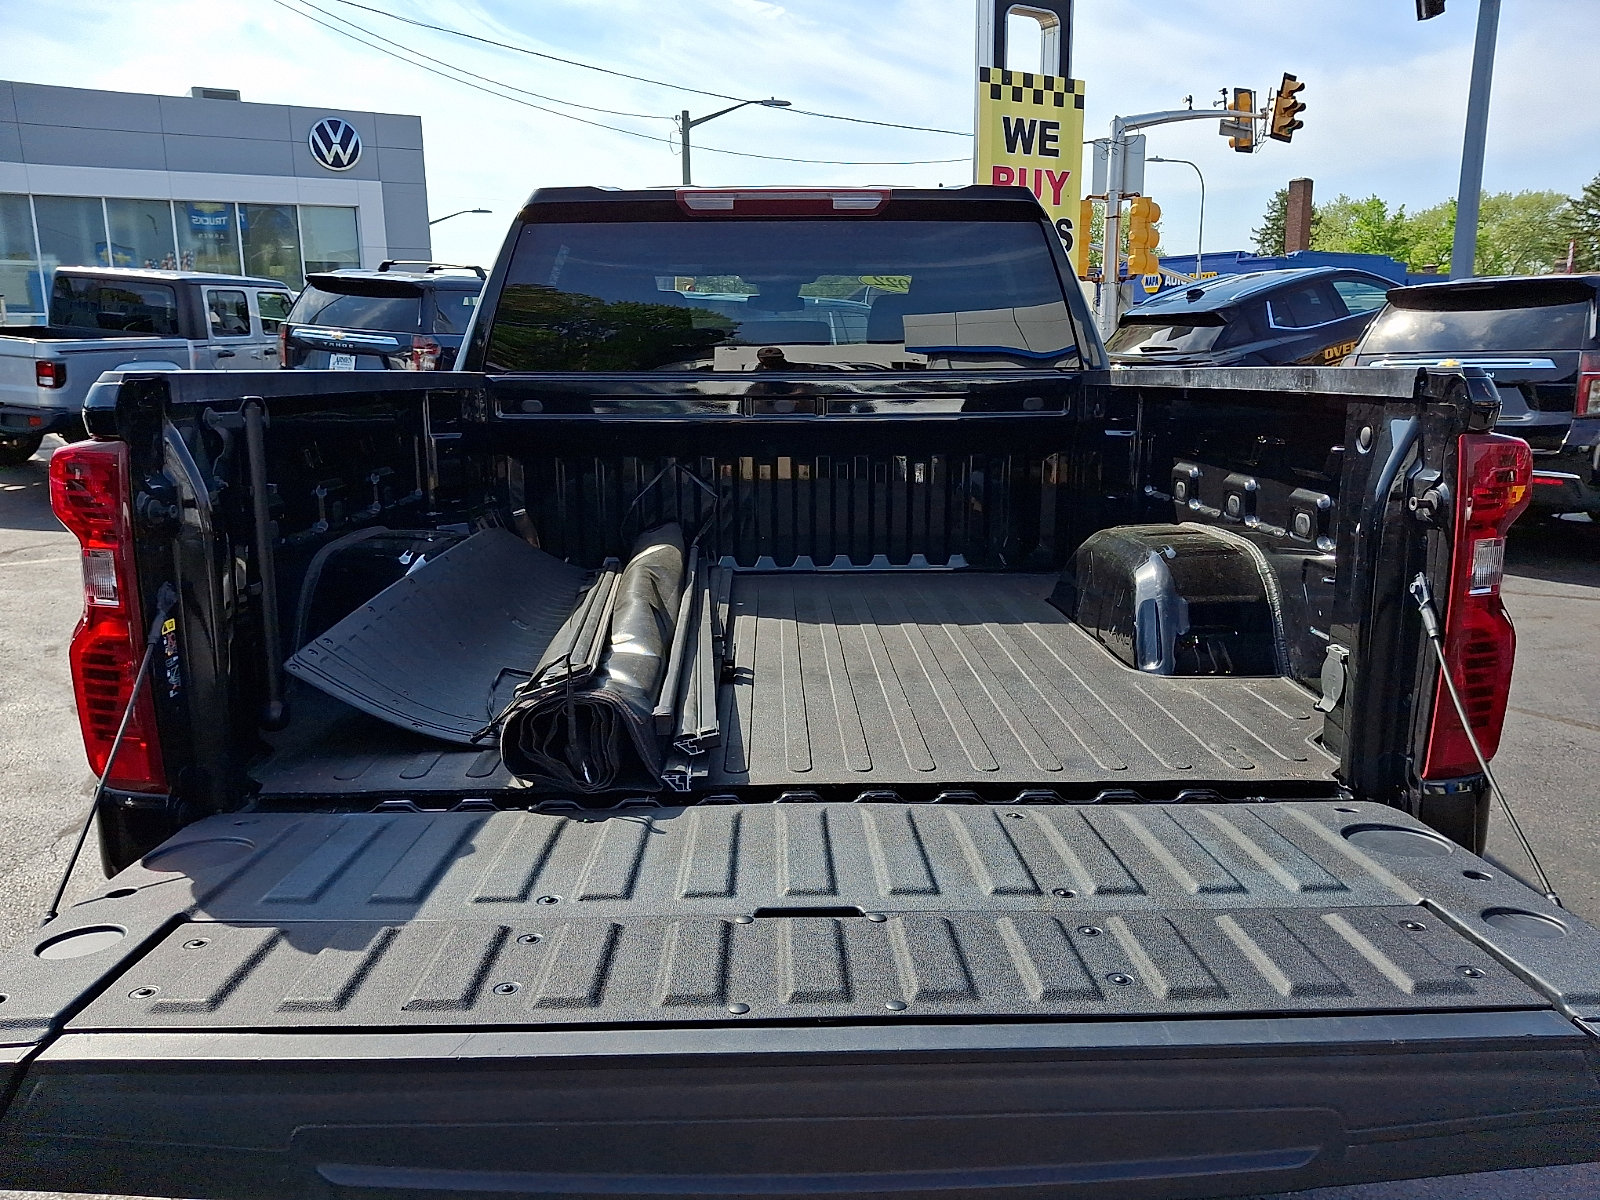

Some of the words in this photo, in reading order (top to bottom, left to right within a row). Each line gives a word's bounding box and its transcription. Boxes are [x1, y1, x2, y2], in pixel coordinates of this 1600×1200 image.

[309, 117, 362, 171] VW
[1002, 116, 1060, 157] WE
[1144, 275, 1159, 287] NAPA
[322, 341, 355, 349] TAHOE
